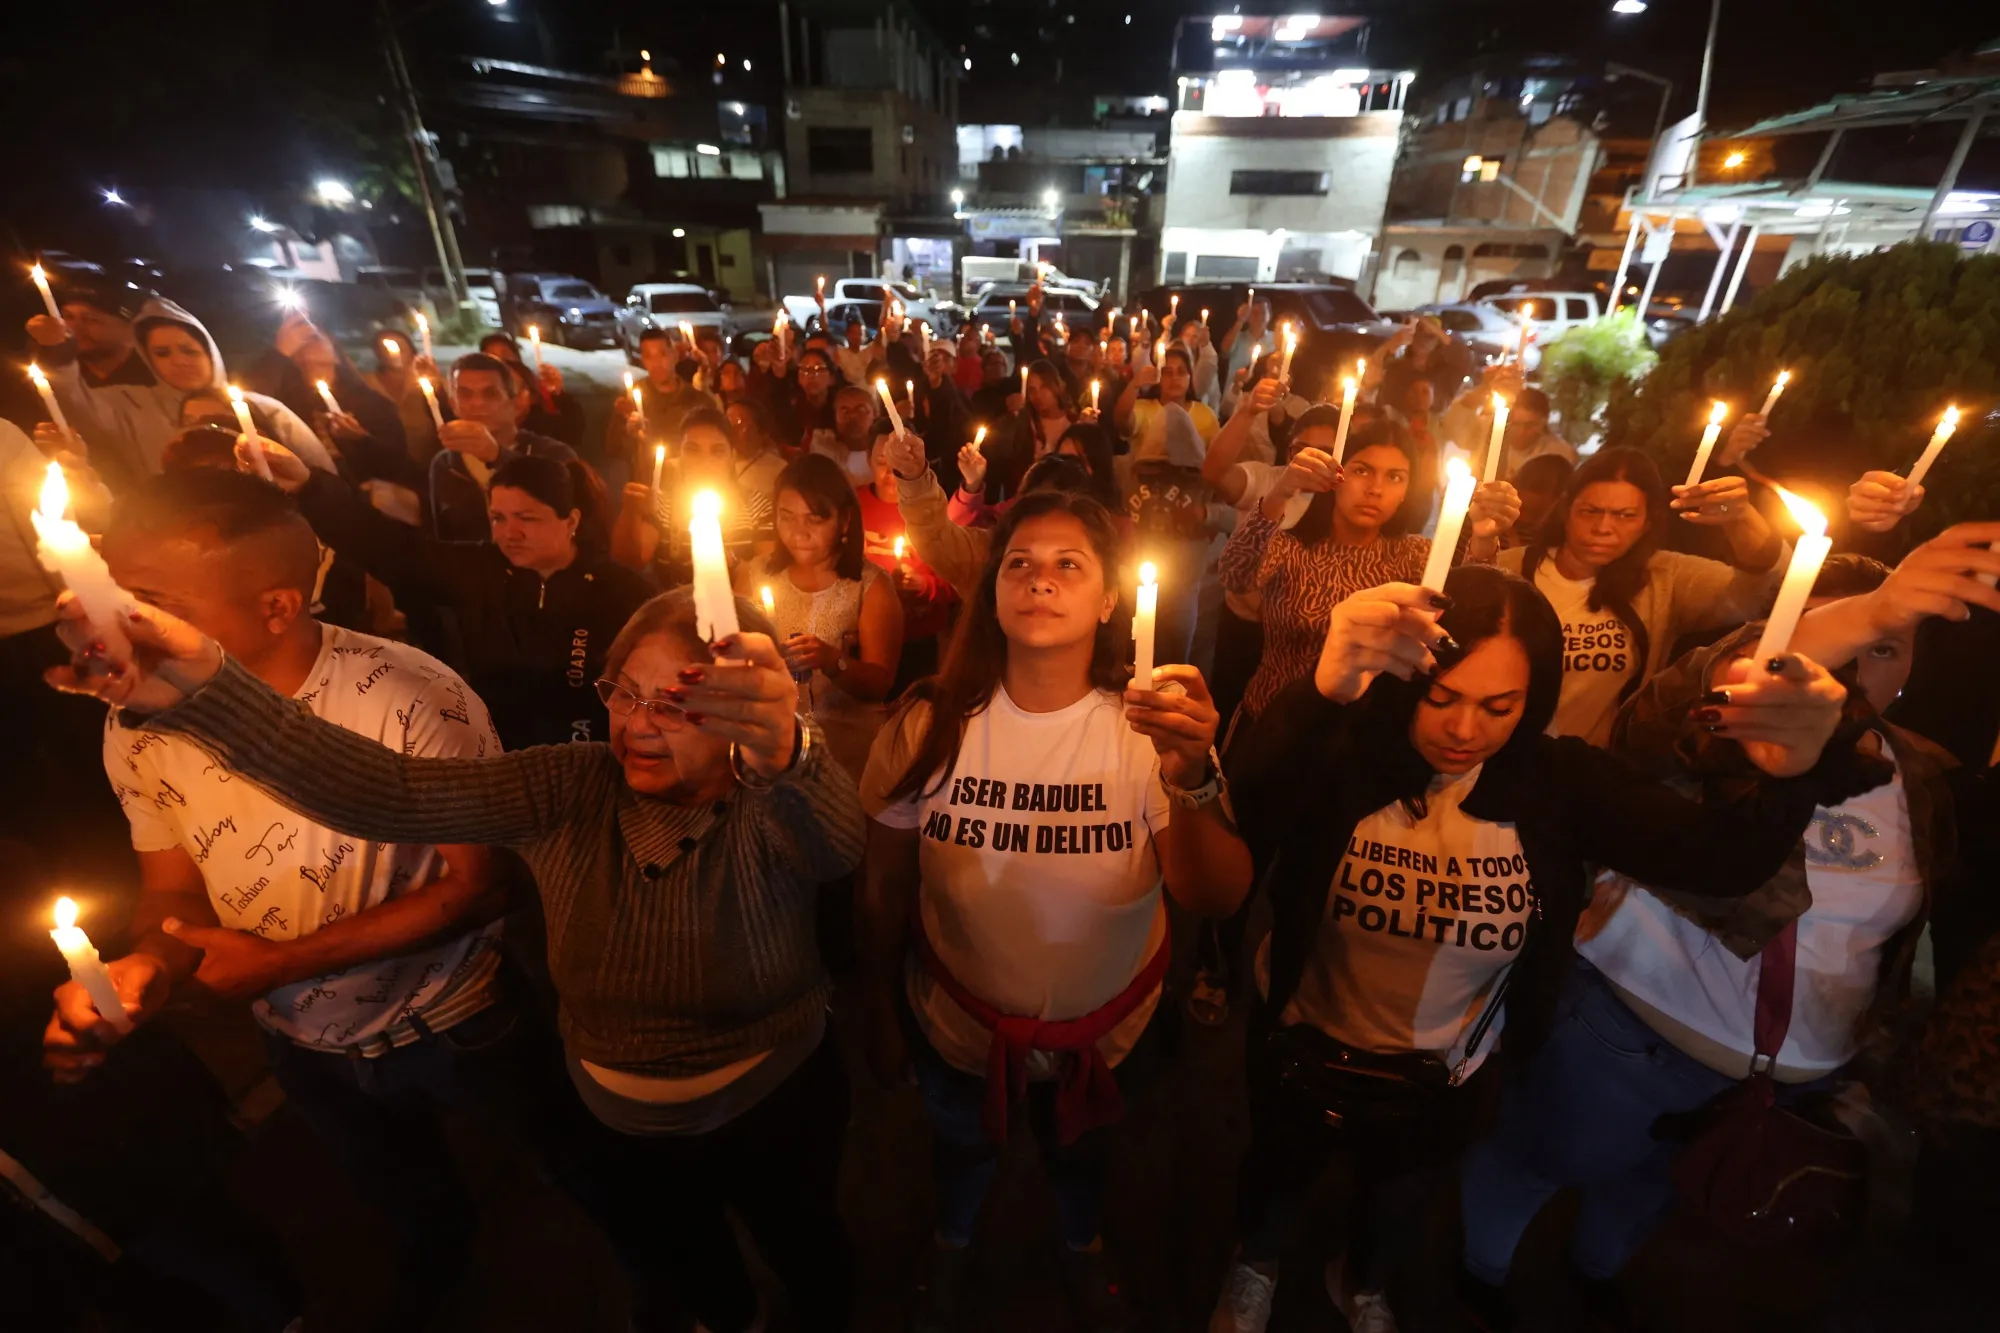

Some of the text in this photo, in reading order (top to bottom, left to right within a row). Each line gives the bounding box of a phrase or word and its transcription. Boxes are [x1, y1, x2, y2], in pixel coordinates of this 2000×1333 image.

[1577, 619, 1626, 635] TODOS
[1563, 653, 1627, 672] ICOS
[949, 776, 1107, 813] ¡SER BADUEL
[922, 810, 1133, 854] NO ES UN DELITO!
[1347, 836, 1529, 878] LIBEREN A TODO
[220, 875, 271, 916] Fashion
[1340, 862, 1406, 902] LOS
